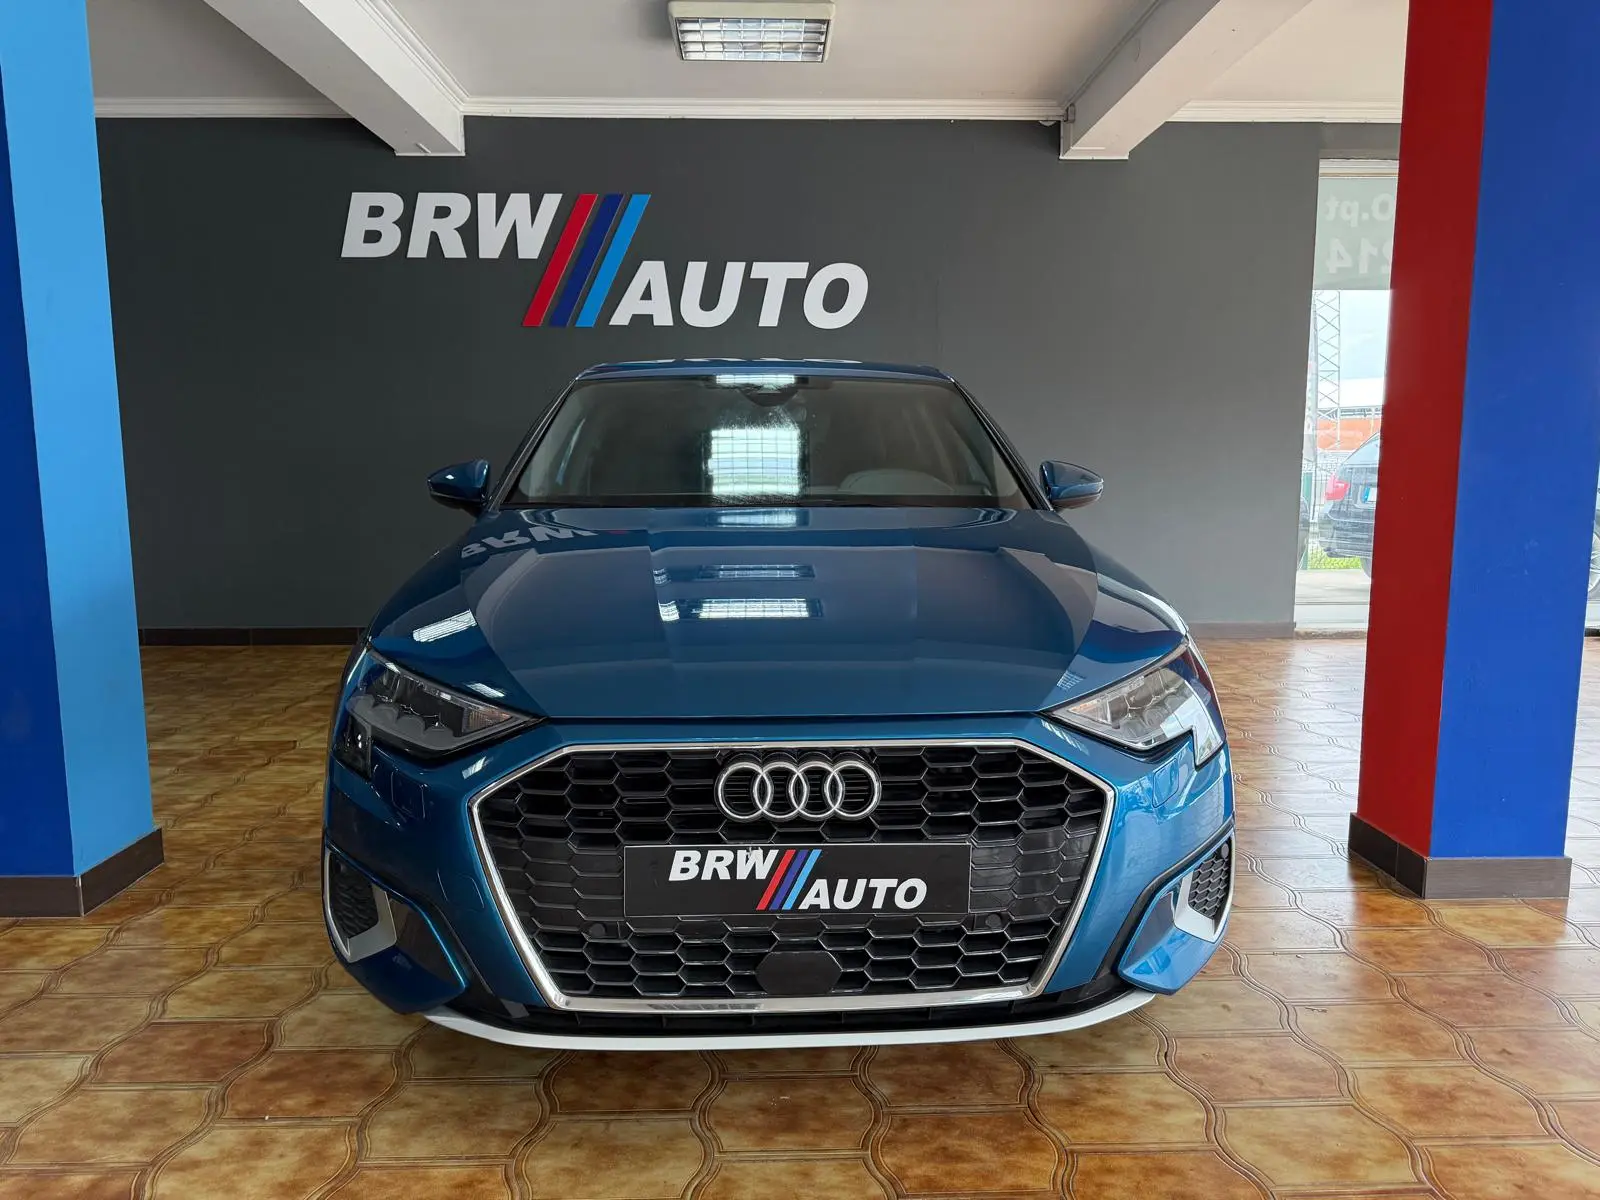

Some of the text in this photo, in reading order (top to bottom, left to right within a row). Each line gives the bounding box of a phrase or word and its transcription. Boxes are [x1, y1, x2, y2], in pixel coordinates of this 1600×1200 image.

[341, 192, 563, 259] BRW
[608, 260, 869, 329] AUTO
[668, 848, 779, 882] BRW
[798, 878, 928, 910] AUTO
